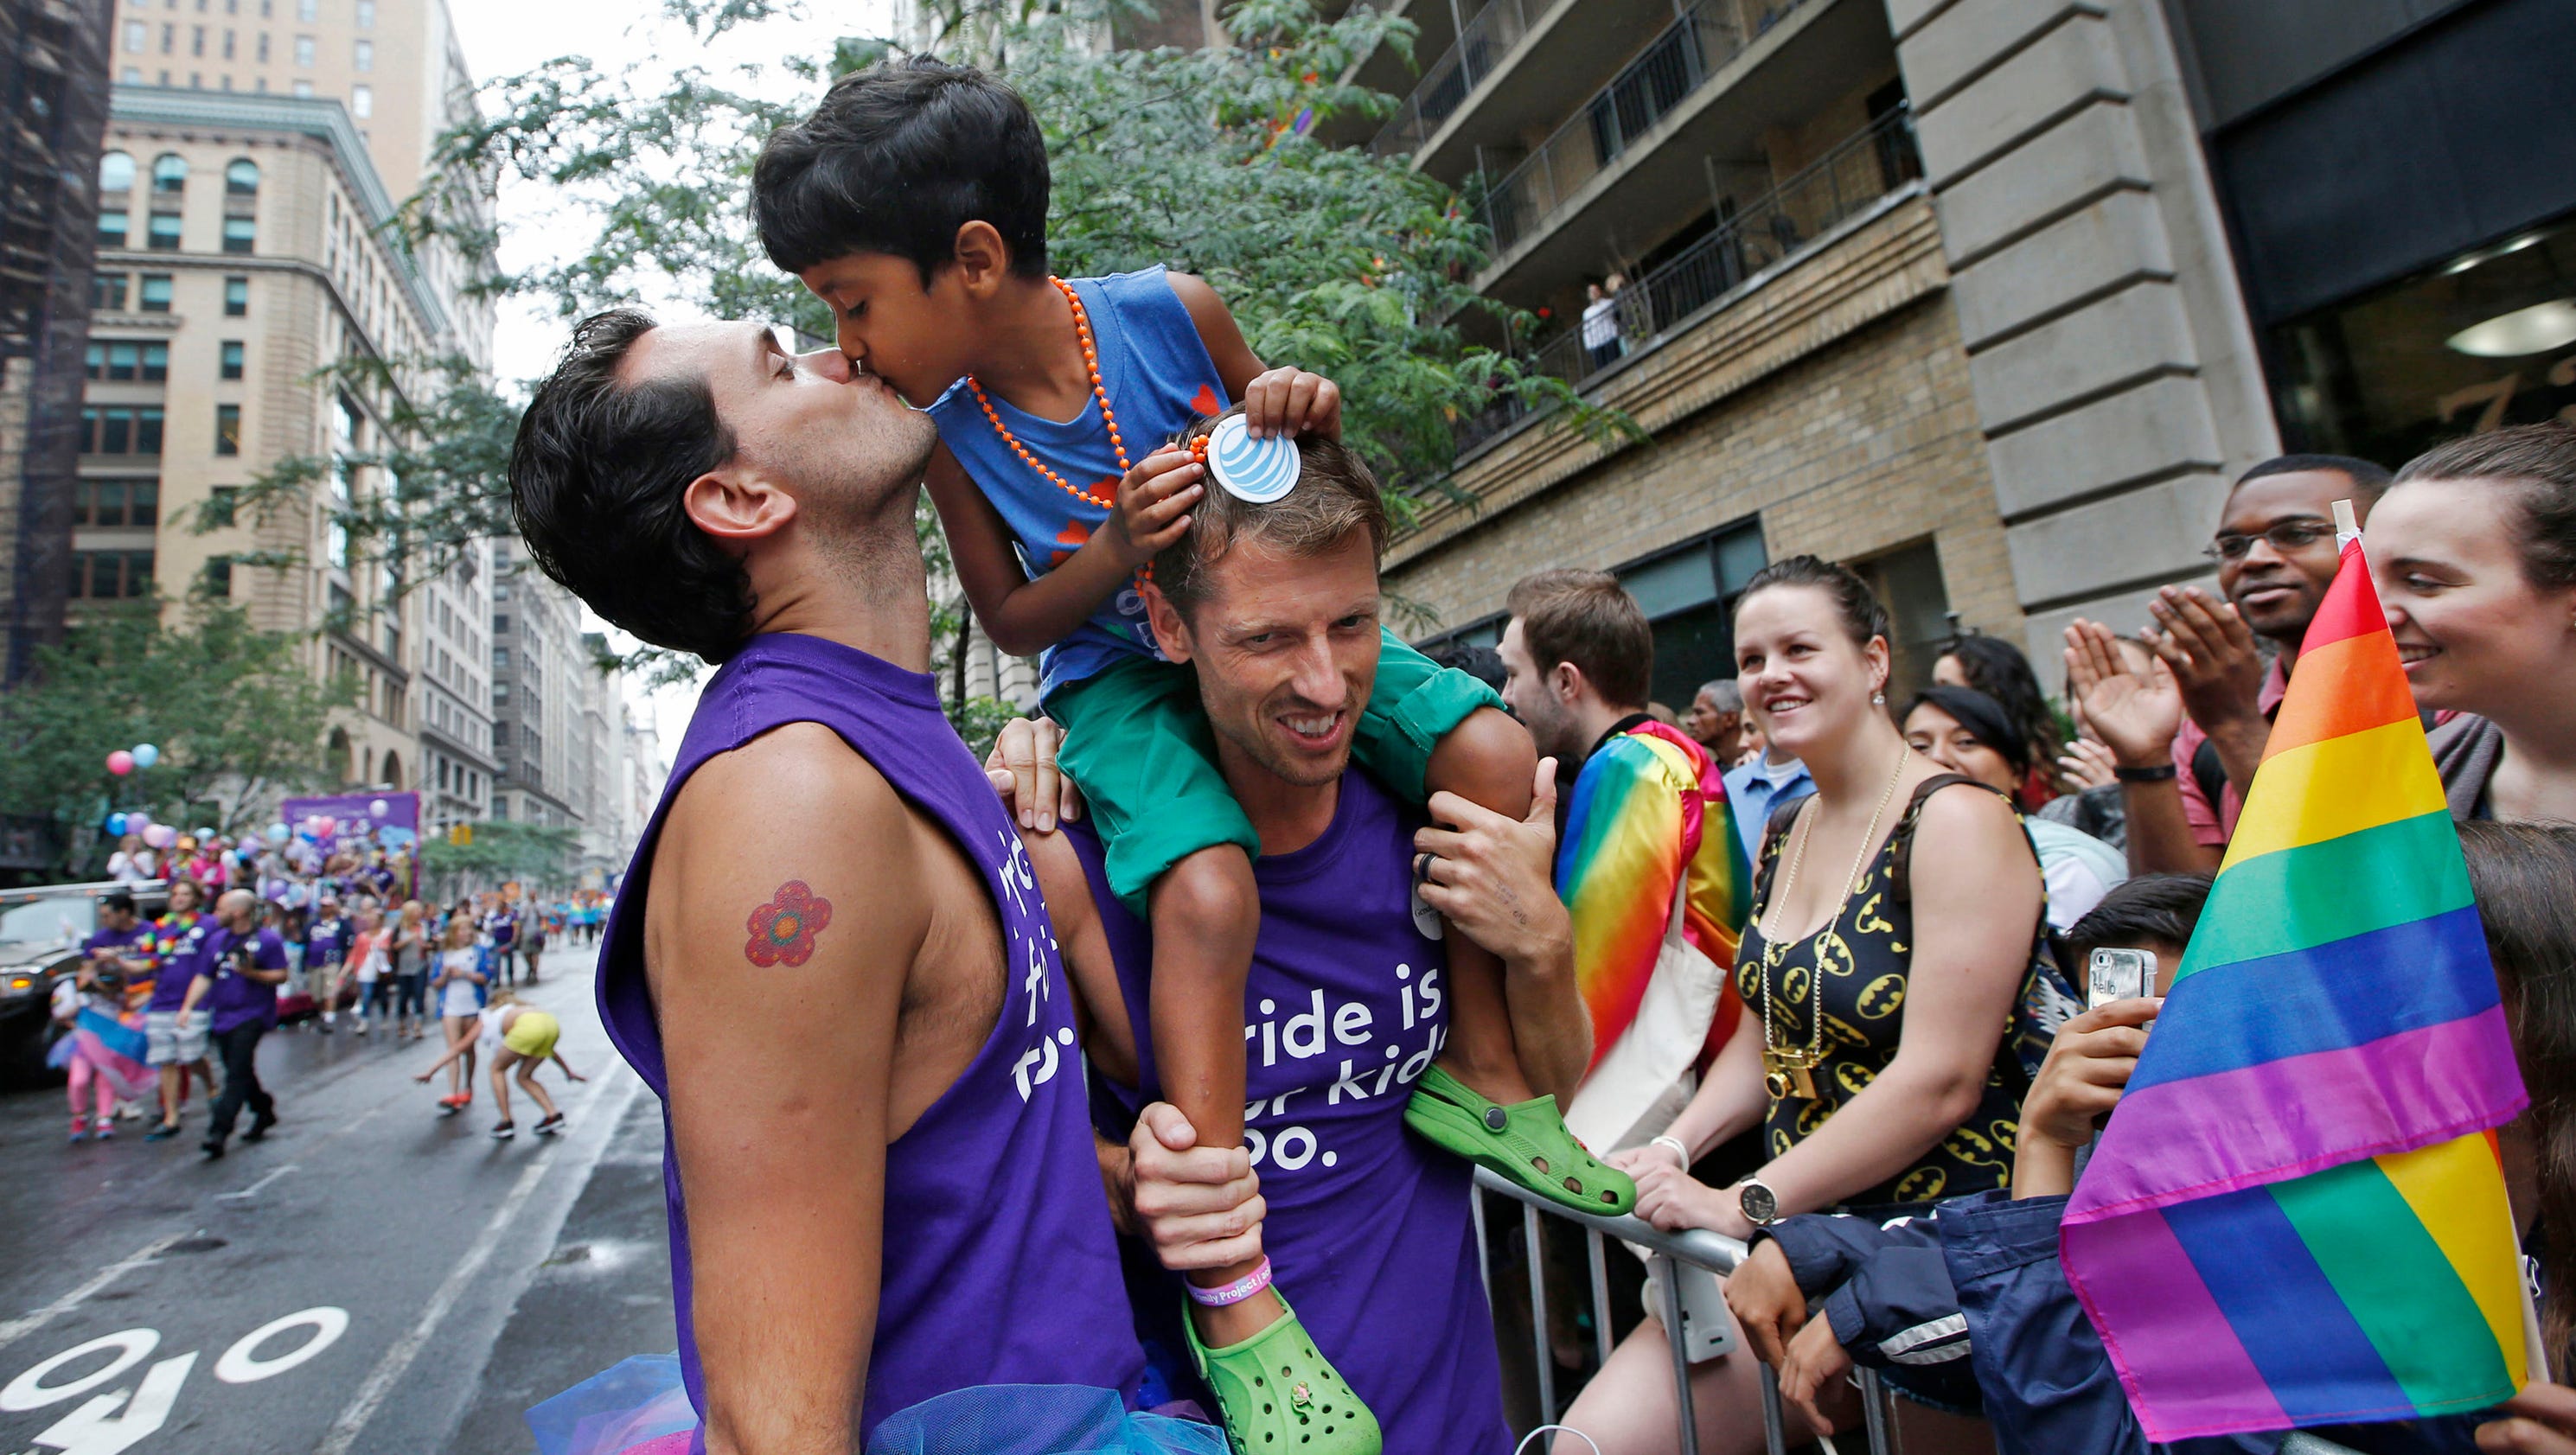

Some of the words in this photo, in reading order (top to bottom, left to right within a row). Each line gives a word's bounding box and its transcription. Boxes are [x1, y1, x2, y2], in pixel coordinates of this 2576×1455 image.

[1396, 963, 1441, 1031] is
[2093, 980, 2116, 995] hello
[1328, 1024, 1448, 1106] kid
[1219, 1278, 1257, 1301] Project
